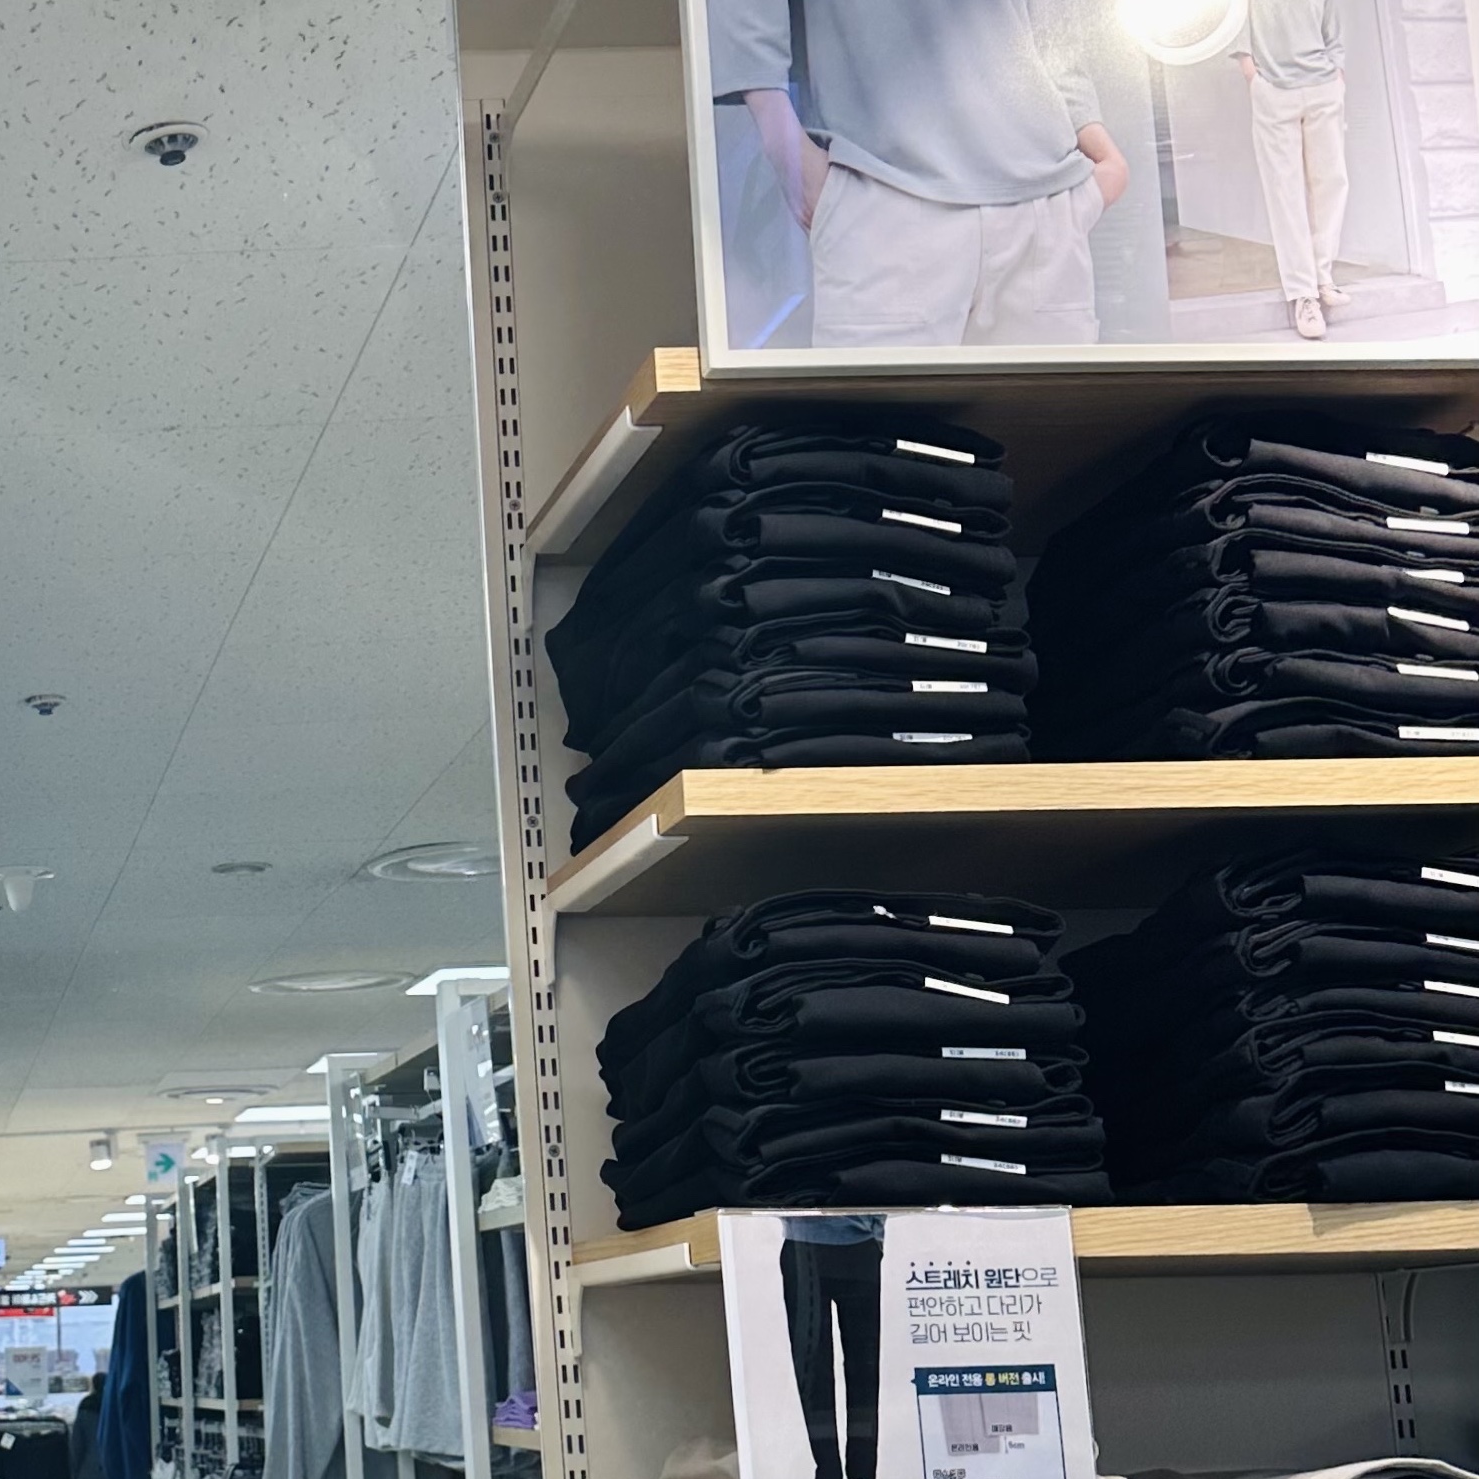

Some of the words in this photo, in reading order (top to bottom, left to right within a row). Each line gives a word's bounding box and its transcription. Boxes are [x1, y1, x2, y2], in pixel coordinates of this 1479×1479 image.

[906, 1268, 980, 1290] 스트레치
[984, 1267, 1059, 1289] 원단으로
[908, 1295, 983, 1318] 편안하고
[987, 1293, 1042, 1316] 다리가
[910, 1322, 948, 1345] 길어
[953, 1322, 1009, 1343] 보이는
[1013, 1320, 1032, 1342] 핏
[928, 1373, 960, 1388] 온라인
[962, 1372, 983, 1387] 전용
[998, 1371, 1020, 1386] 버전
